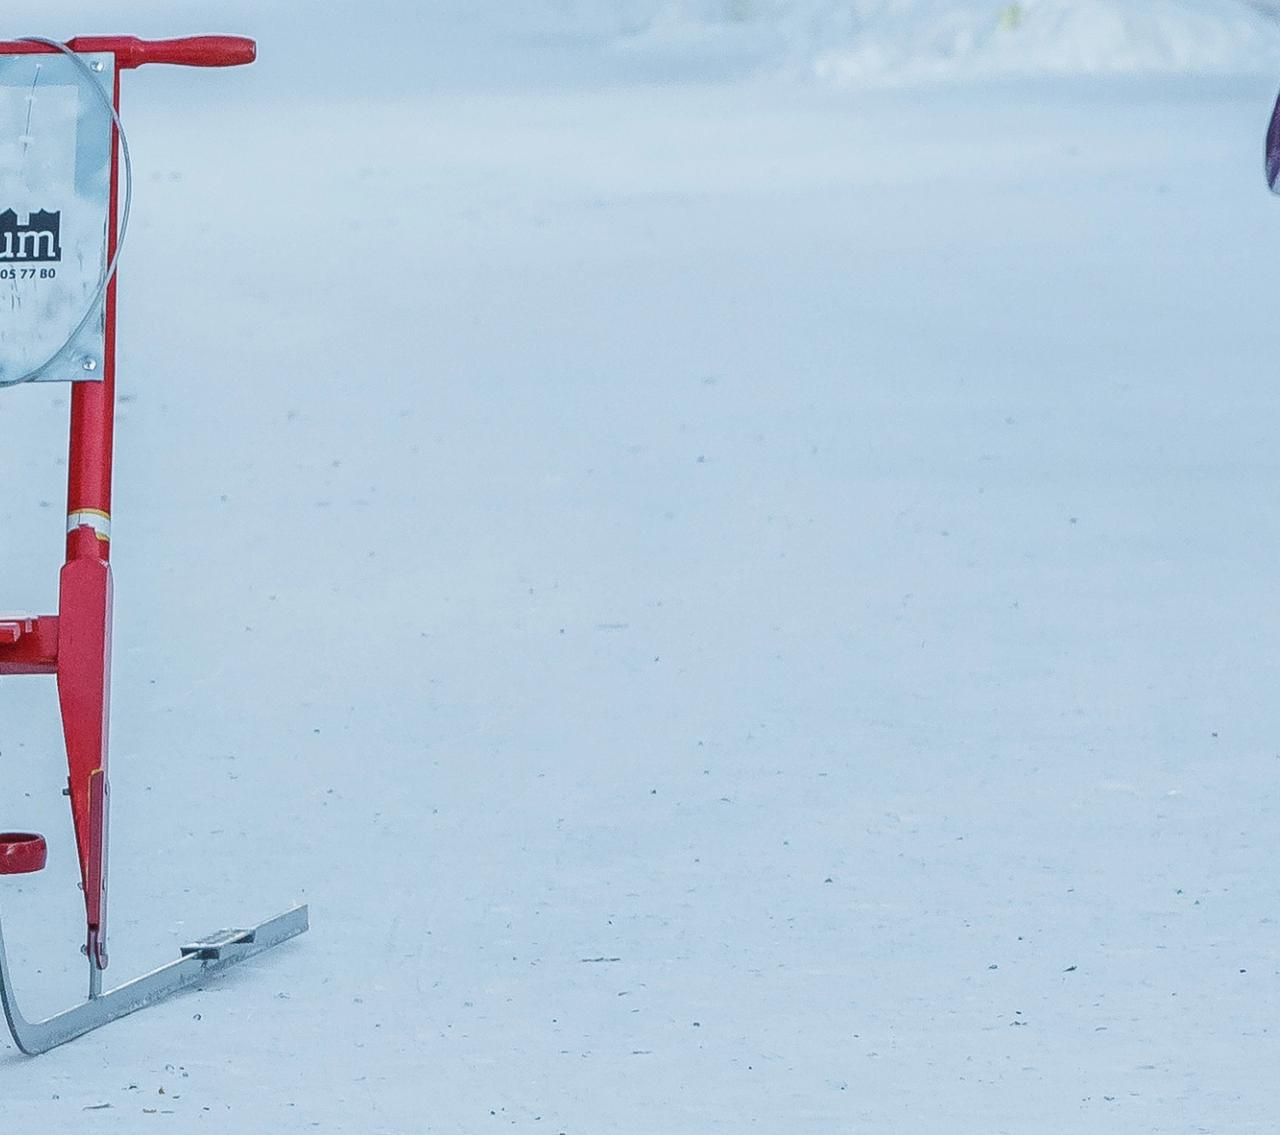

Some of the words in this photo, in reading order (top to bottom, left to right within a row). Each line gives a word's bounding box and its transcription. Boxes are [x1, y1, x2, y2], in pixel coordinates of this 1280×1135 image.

[0, 269, 16, 279] 05
[20, 268, 36, 279] 77
[39, 268, 56, 279] 80
